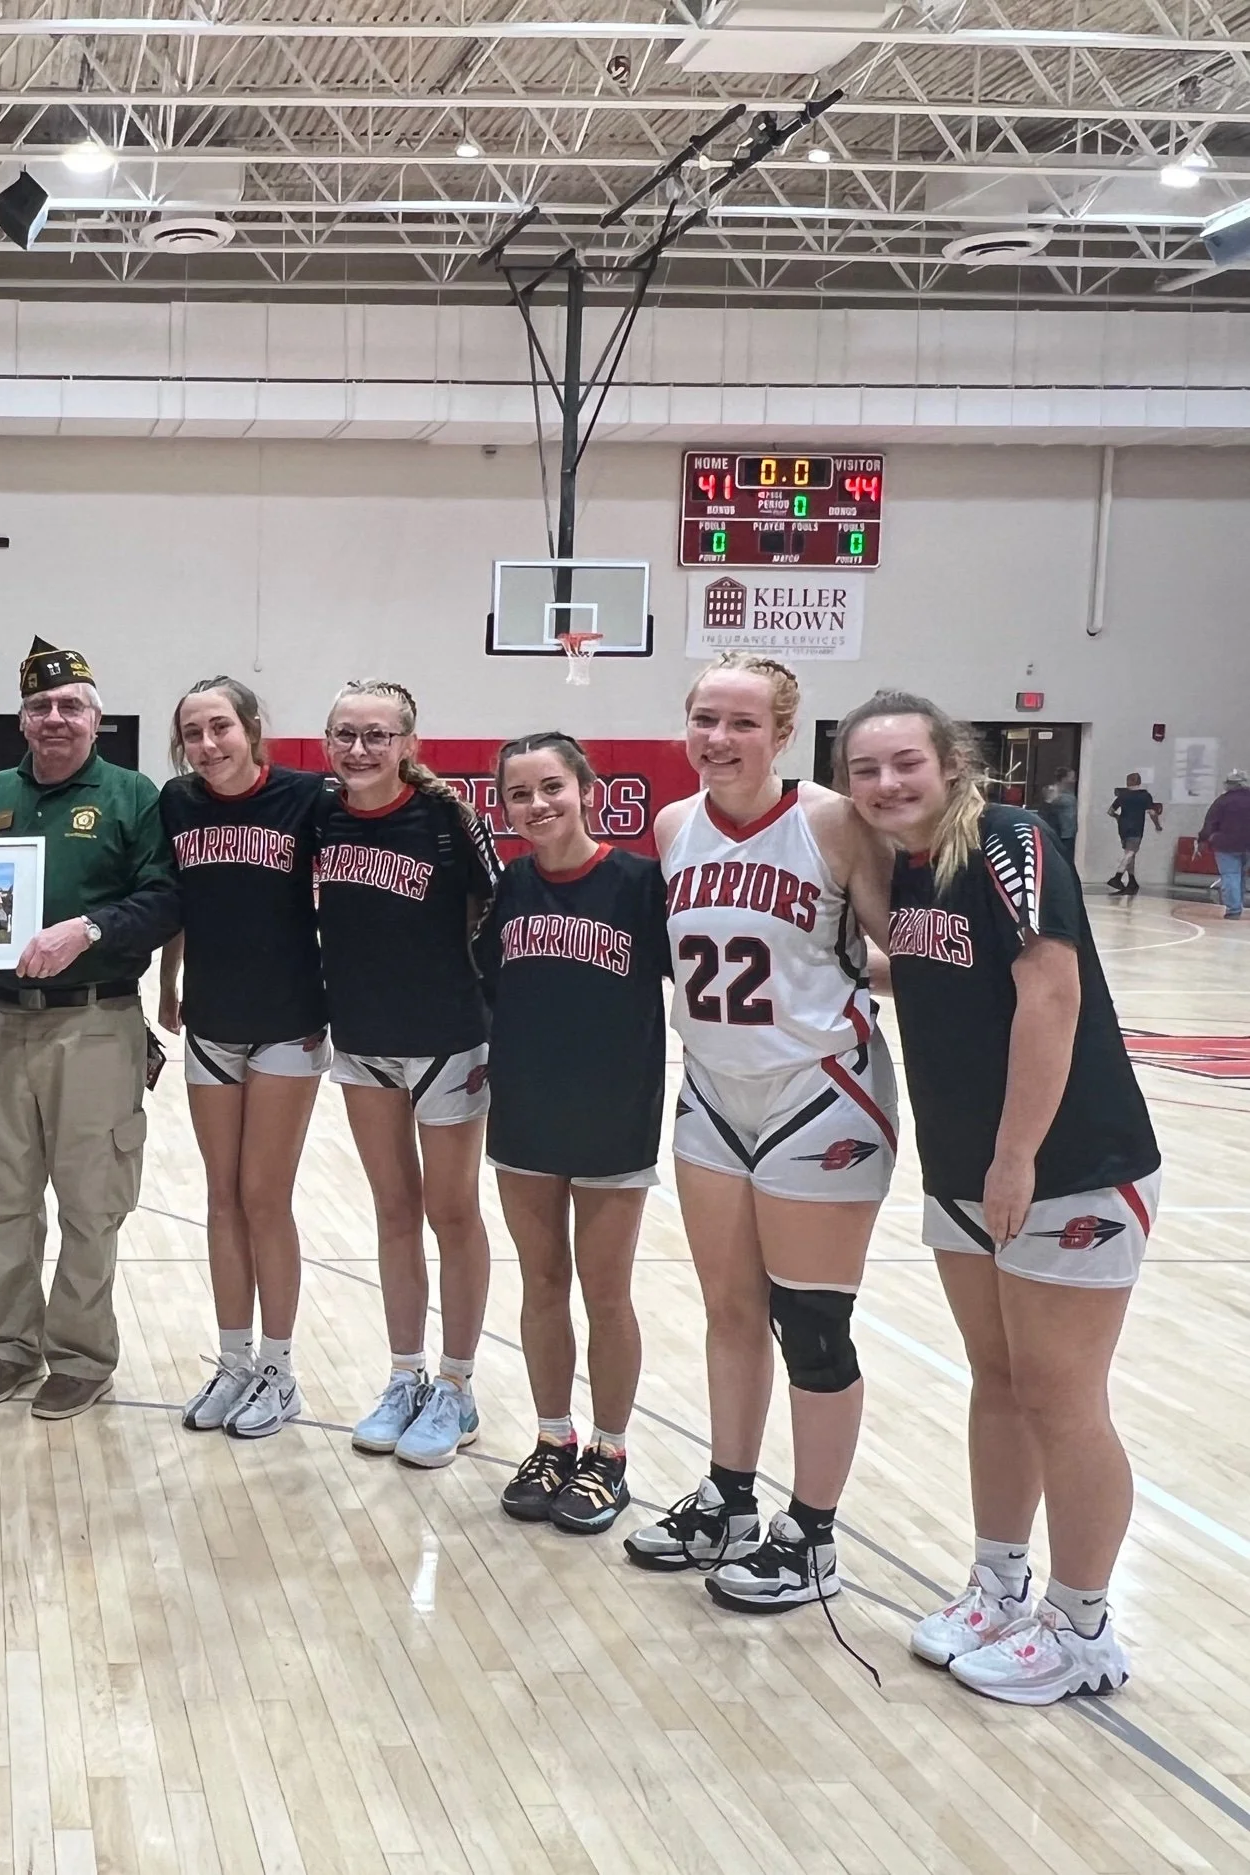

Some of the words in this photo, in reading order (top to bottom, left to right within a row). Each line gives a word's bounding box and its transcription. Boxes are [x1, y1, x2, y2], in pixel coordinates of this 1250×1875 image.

[694, 457, 729, 470] HOME
[760, 459, 809, 486] 0.0
[835, 459, 881, 472] VISITOR
[698, 474, 732, 500] 41
[845, 476, 878, 502] 44
[793, 495, 807, 517] 0
[712, 532, 726, 553] 0
[849, 532, 864, 554] 0
[754, 587, 848, 609] KELLER
[753, 610, 846, 631] BROWN
[701, 634, 778, 646] INSURANCE
[783, 635, 847, 647] SERVICES
[678, 934, 775, 1027] 22
